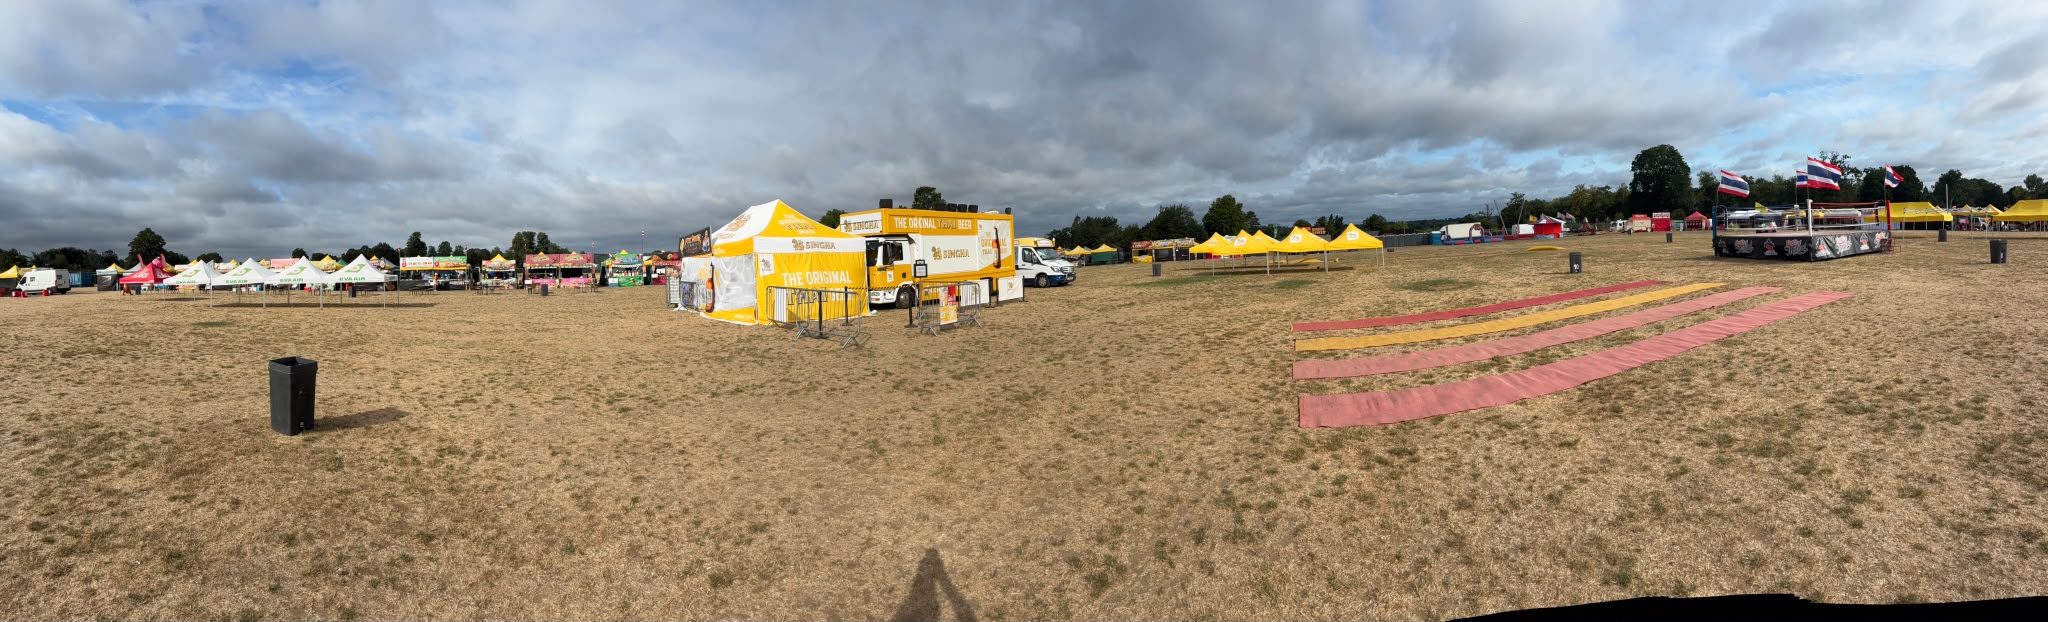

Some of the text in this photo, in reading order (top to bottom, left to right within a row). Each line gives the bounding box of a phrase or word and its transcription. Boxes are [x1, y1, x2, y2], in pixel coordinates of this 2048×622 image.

[853, 220, 879, 230] SINGHA
[894, 217, 972, 230] THE ORIGINAL THAI BEER
[805, 241, 836, 250] SINGHA
[943, 248, 970, 259] SINGHA
[782, 270, 852, 287] THE ORIGINAL
[786, 287, 828, 306] THAI
